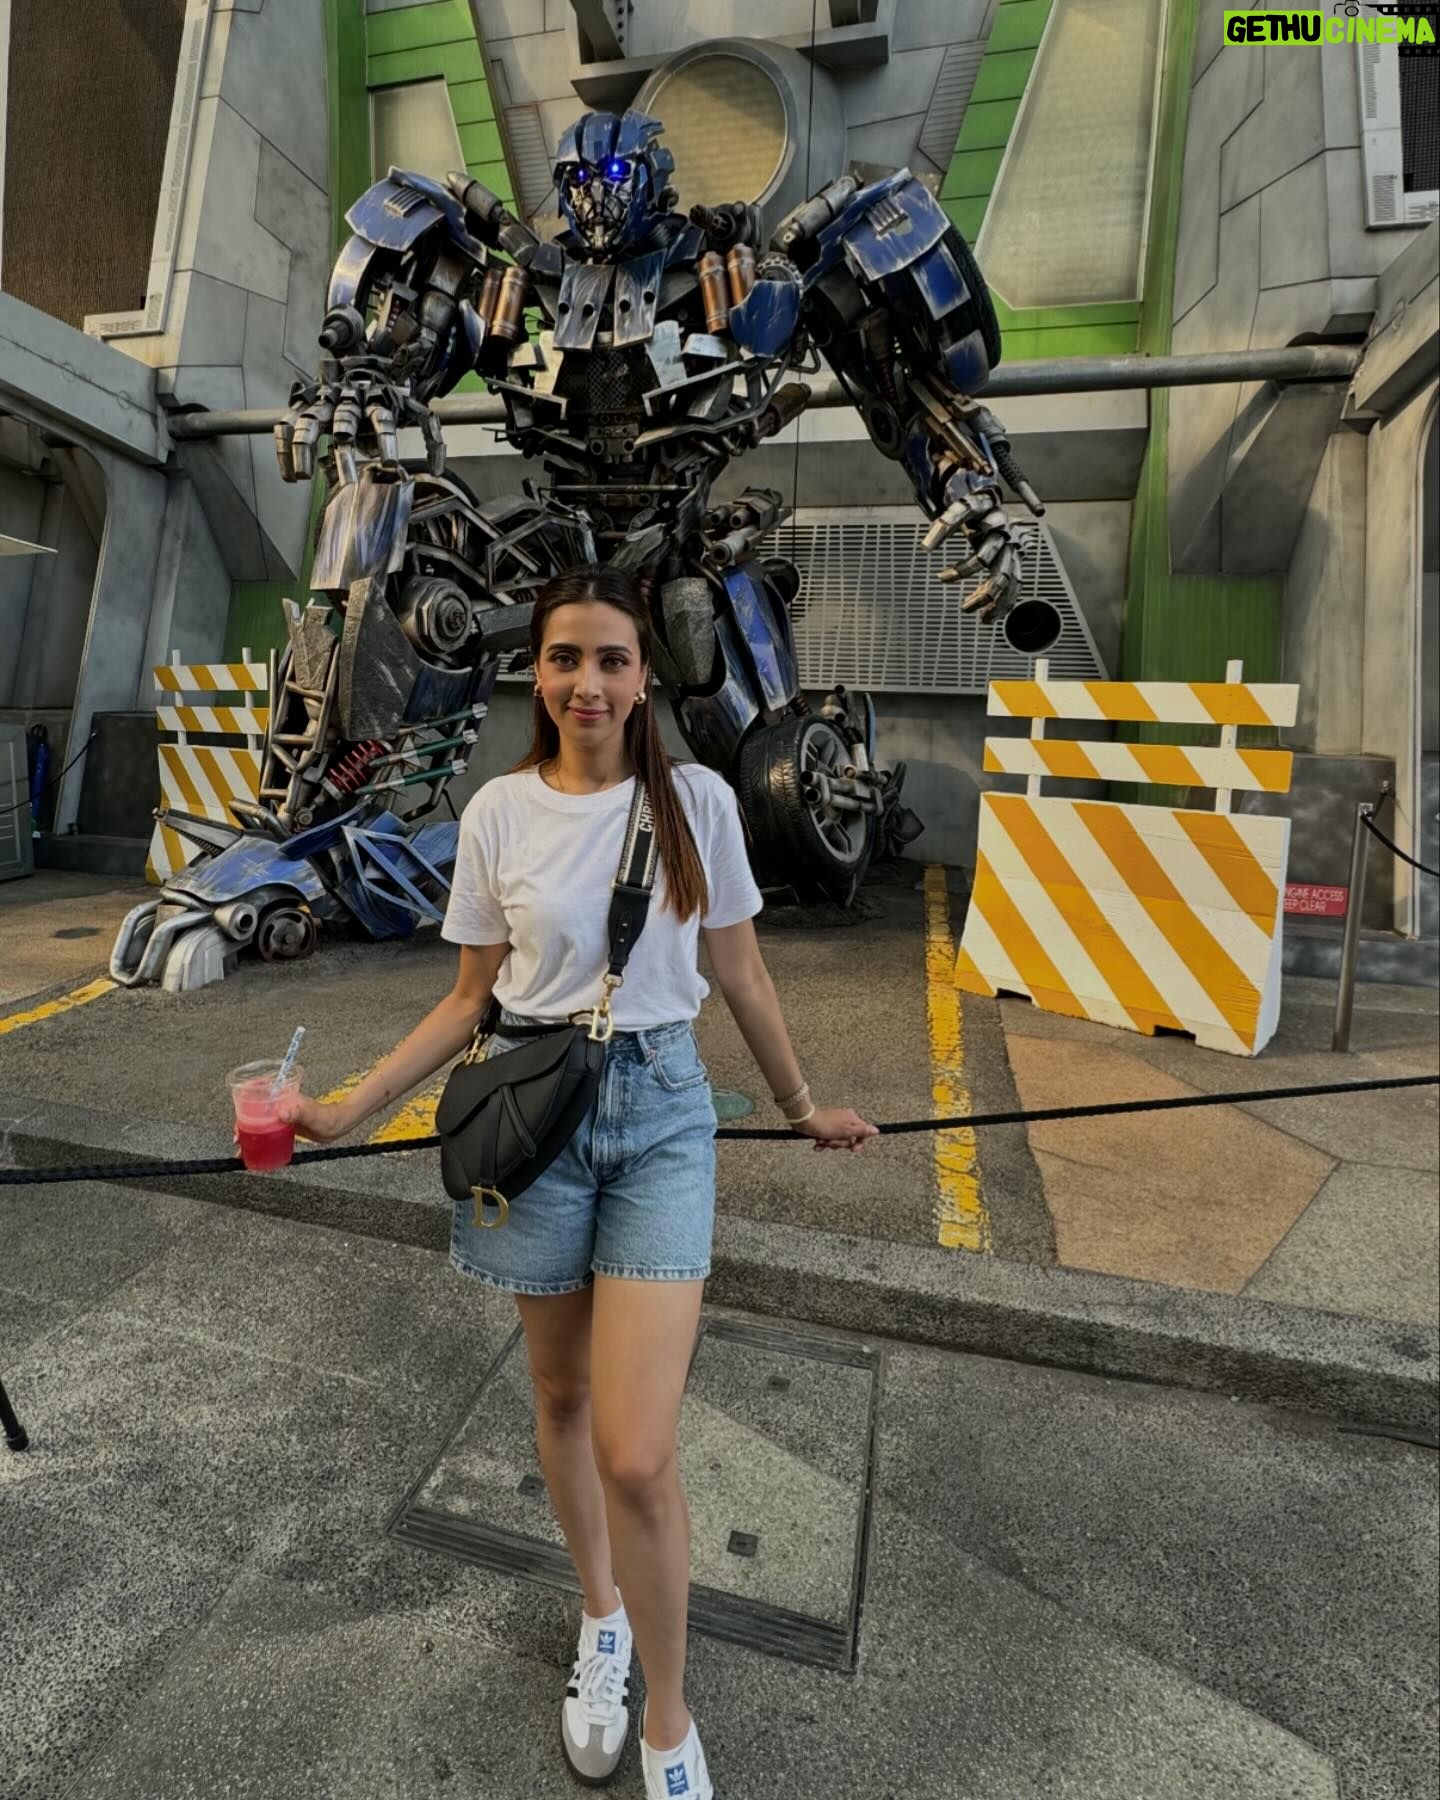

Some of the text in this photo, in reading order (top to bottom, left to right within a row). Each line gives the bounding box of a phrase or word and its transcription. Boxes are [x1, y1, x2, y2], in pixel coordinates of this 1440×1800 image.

[1286, 887, 1345, 903] NGINE ACCESS
[1283, 899, 1327, 912] EEP CLEAR
[471, 1186, 509, 1230] D
